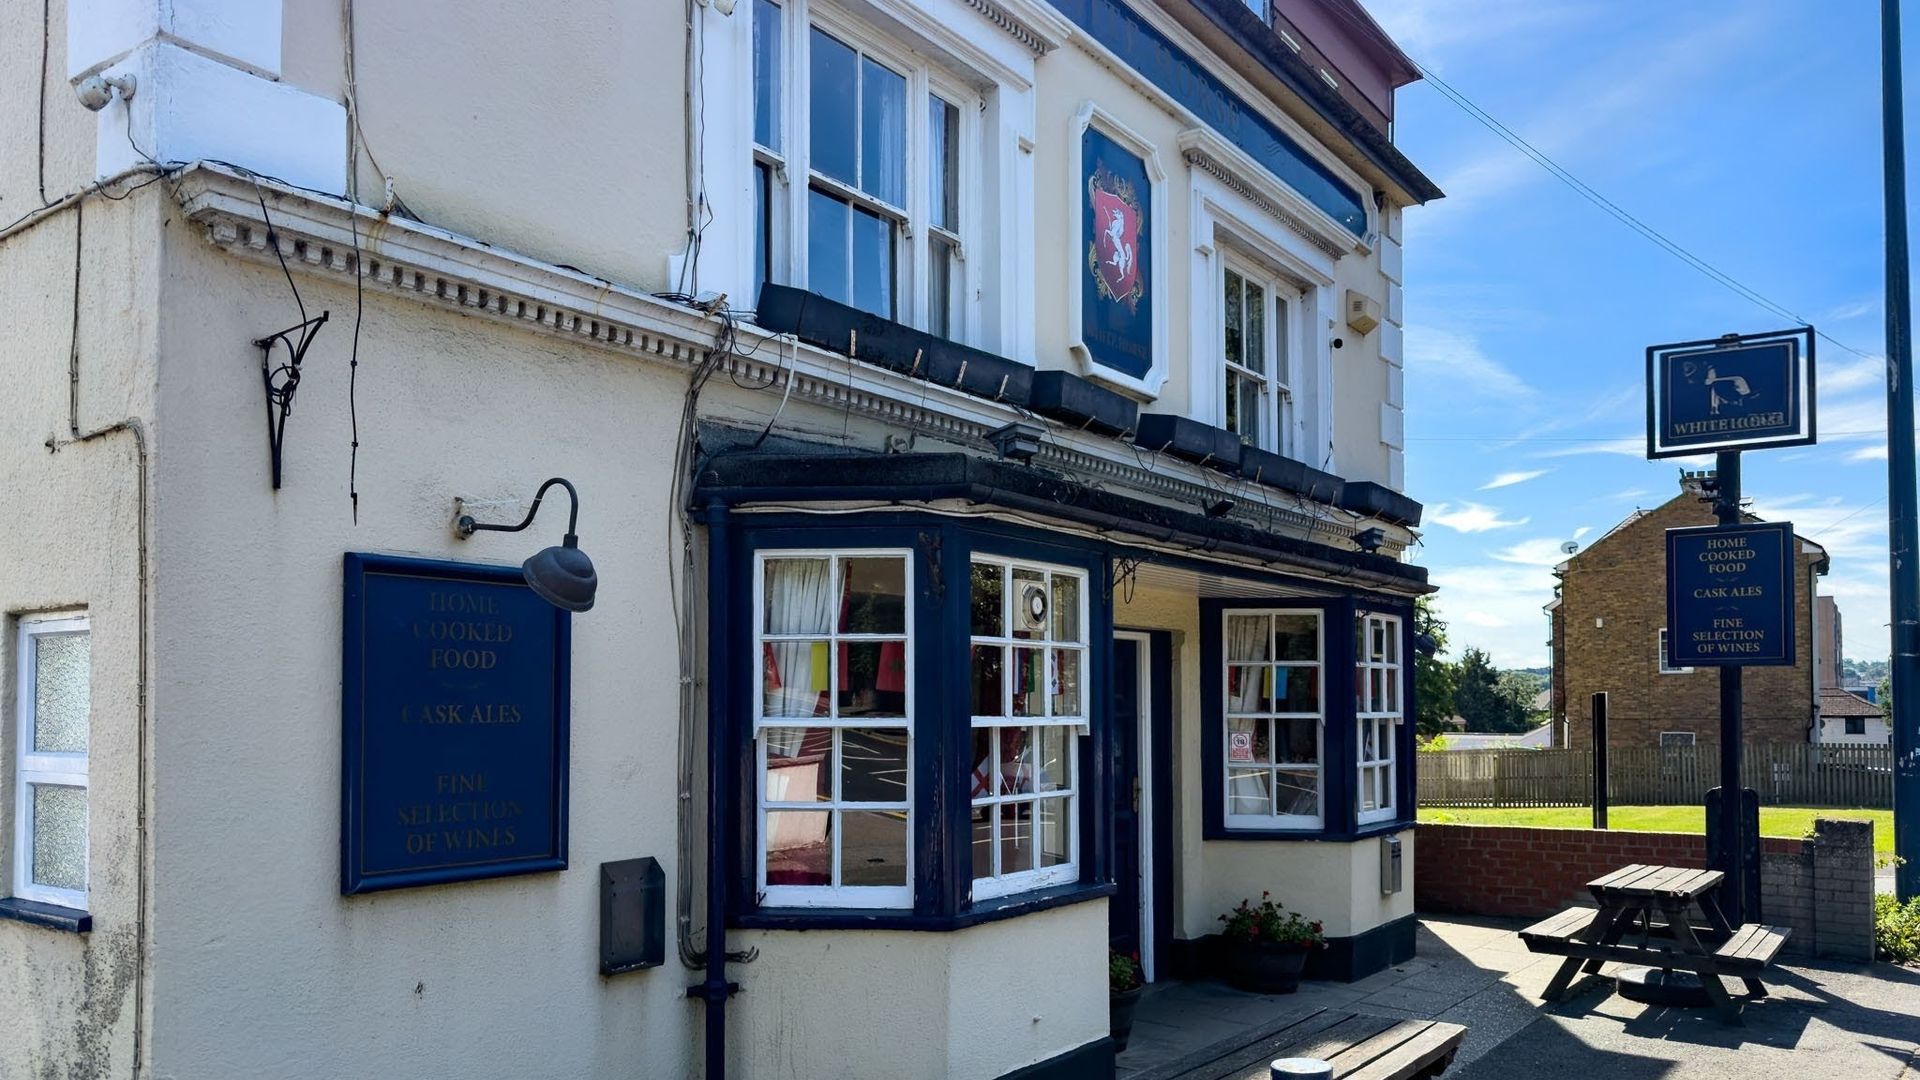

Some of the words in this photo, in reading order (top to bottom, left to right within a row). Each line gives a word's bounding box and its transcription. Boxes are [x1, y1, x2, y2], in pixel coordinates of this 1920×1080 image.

[1673, 419, 1728, 435] WHITE
[1707, 537, 1747, 549] HOME
[1699, 550, 1756, 562] COOKED
[1709, 562, 1746, 574] FOOD
[1694, 587, 1727, 599] CASK
[1731, 586, 1762, 597] ALES
[1713, 618, 1743, 629] FINE
[1692, 630, 1764, 641] SELECTION
[1697, 643, 1715, 654] OF
[1718, 642, 1760, 653] WINES
[432, 649, 497, 670] FOOD
[470, 703, 521, 723] ALES
[407, 833, 438, 854] OF
